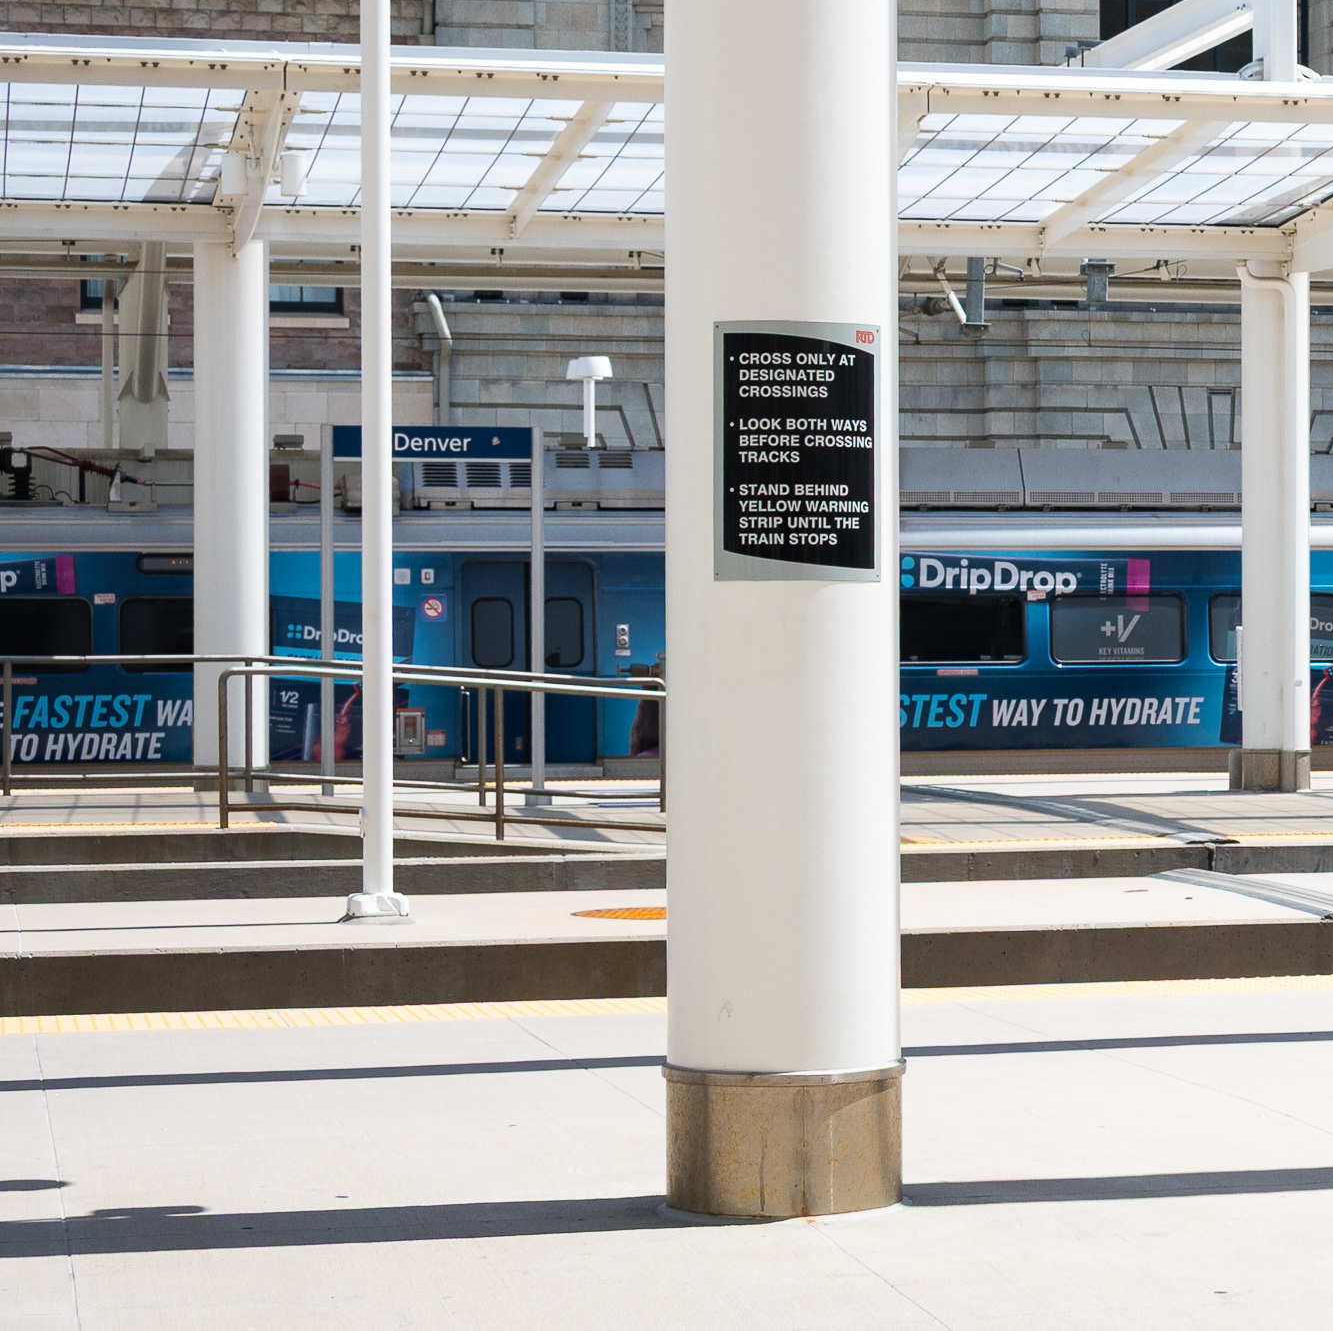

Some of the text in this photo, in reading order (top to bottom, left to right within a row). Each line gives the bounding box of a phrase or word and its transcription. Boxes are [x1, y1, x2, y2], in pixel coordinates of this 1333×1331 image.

[856, 331, 875, 344] RTD
[739, 353, 856, 366] CROSS ONLY AT
[739, 369, 835, 382] DESIGNATED
[739, 386, 828, 398] CROSSINGS
[739, 419, 867, 432] LOOK BOTH WAYS
[394, 433, 472, 452] Denver
[739, 435, 873, 449] BEFORE CROSSING
[739, 451, 800, 463] TRACKS
[739, 484, 849, 496] STAND BEHIND
[739, 500, 869, 513] YELLOW WARNING
[739, 517, 860, 529] STRIP UNTIL THE
[739, 533, 838, 545] TRAIN STOPS
[919, 558, 1077, 596] DripDrop
[303, 625, 363, 645] DrDro
[1098, 647, 1145, 655] KEY VITAMINS
[13, 694, 152, 729] FASTEST
[157, 700, 193, 727] WA
[900, 693, 1205, 728] STEST WAY TO HYDRATE
[10, 732, 166, 761] TO HYDRATE
